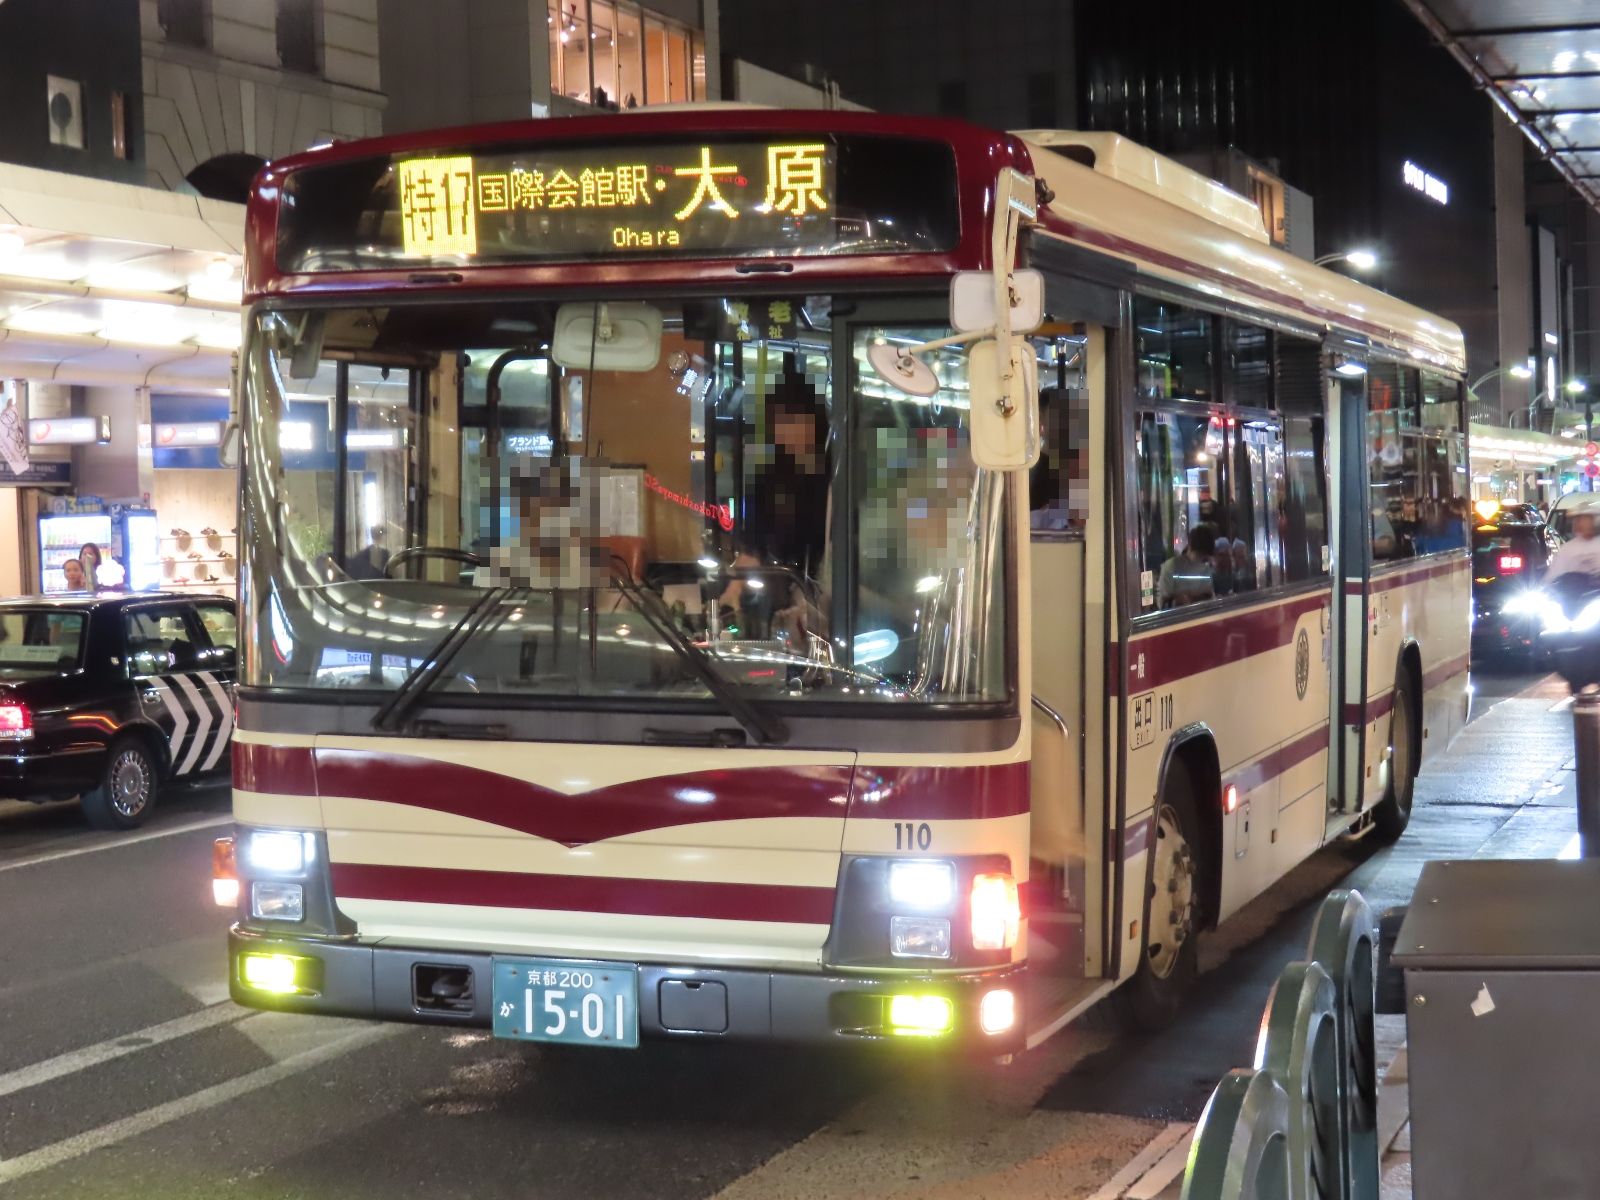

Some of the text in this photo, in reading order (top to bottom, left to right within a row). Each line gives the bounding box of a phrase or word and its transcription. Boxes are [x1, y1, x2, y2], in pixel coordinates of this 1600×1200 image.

[403, 169, 472, 242] 特17
[612, 227, 681, 248] Ohara
[1134, 696, 1152, 730] 出口
[1160, 692, 1173, 732] 110
[894, 822, 932, 851] 110
[500, 988, 624, 1040] か 15-01
